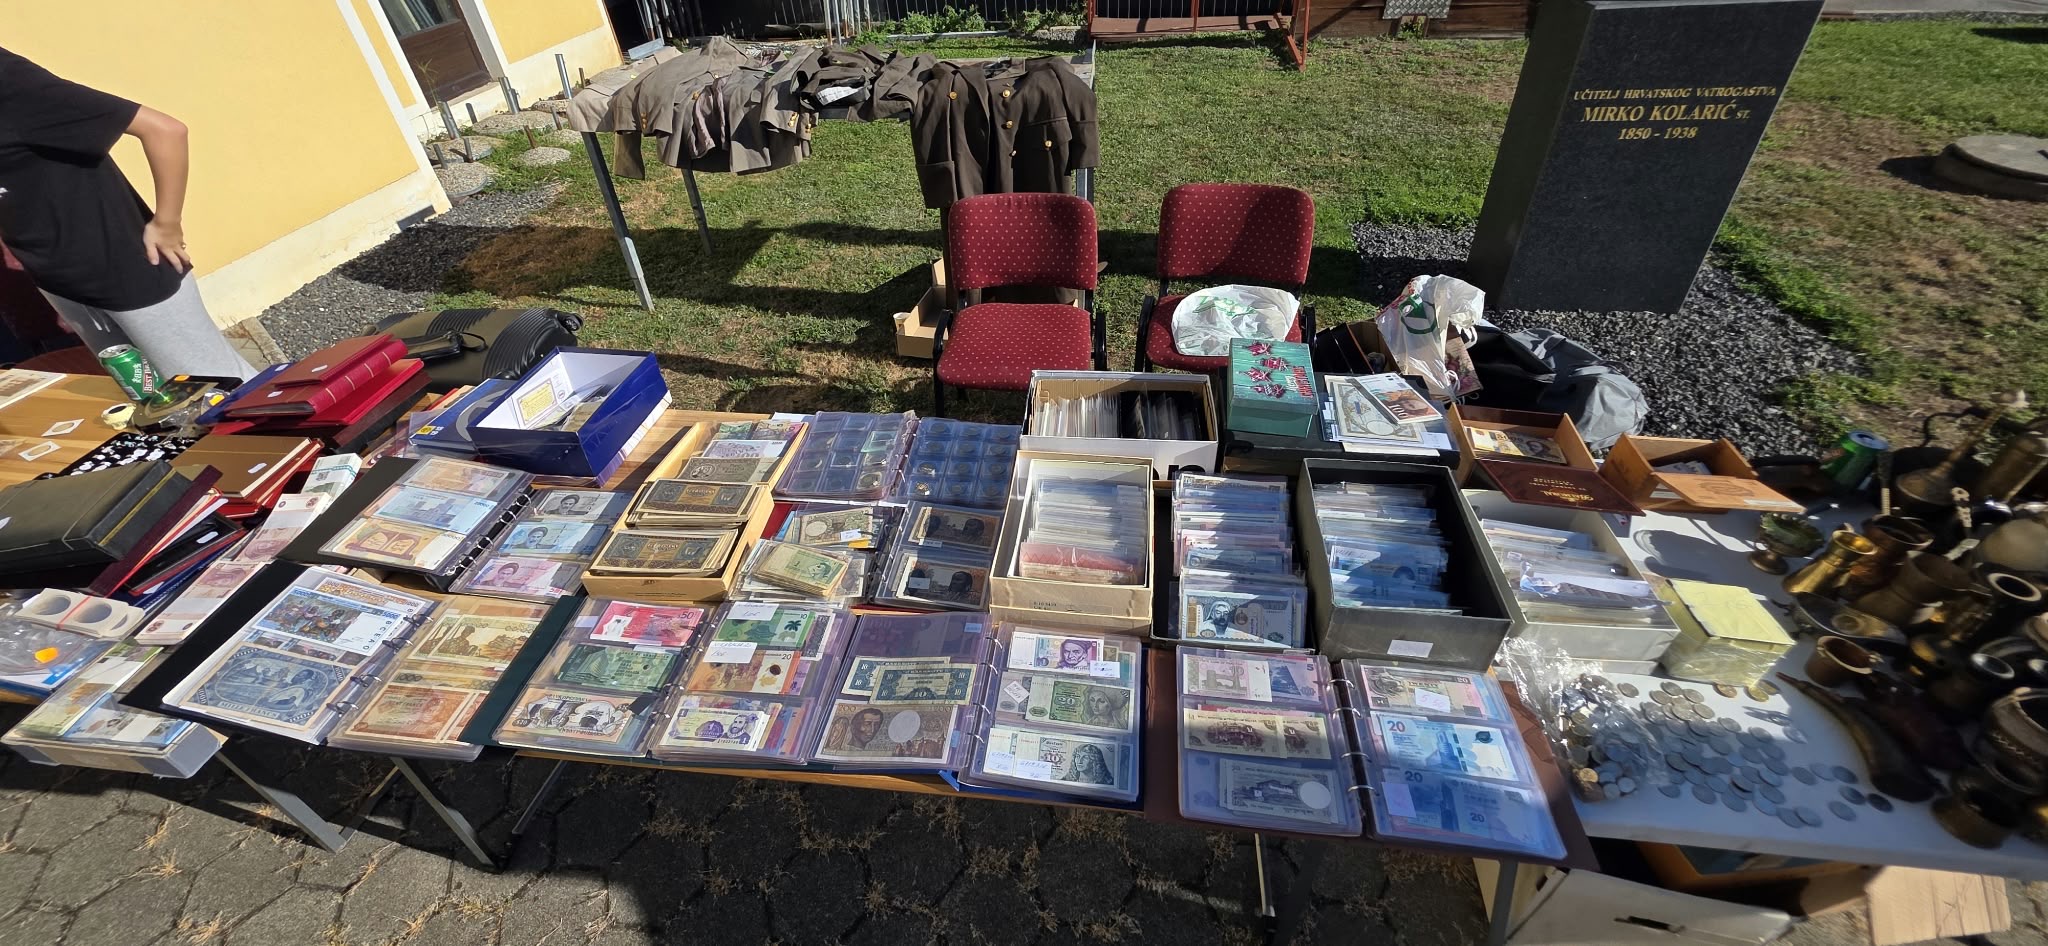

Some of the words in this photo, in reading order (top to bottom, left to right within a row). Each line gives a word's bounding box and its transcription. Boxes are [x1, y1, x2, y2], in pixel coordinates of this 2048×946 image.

[1573, 88, 1620, 101] UČITELJ
[1624, 87, 1692, 100] HRVATSKOG
[1696, 86, 1777, 98] VATROGASTVA
[1580, 105, 1644, 122] MIRKO
[1649, 100, 1736, 121] KOLARIĆ
[1618, 127, 1651, 140] 1850
[1663, 126, 1698, 139] 1938
[144, 374, 153, 392] BEST
[1388, 404, 1408, 417] 100
[383, 611, 400, 620] 5000
[680, 611, 695, 620] 50
[1456, 676, 1469, 684] 20
[249, 706, 279, 718] FRANCS
[1387, 720, 1406, 732] 20
[741, 737, 748, 745] 1
[1049, 754, 1061, 762] 10
[1404, 771, 1423, 782] 20
[1470, 812, 1485, 823] 20
